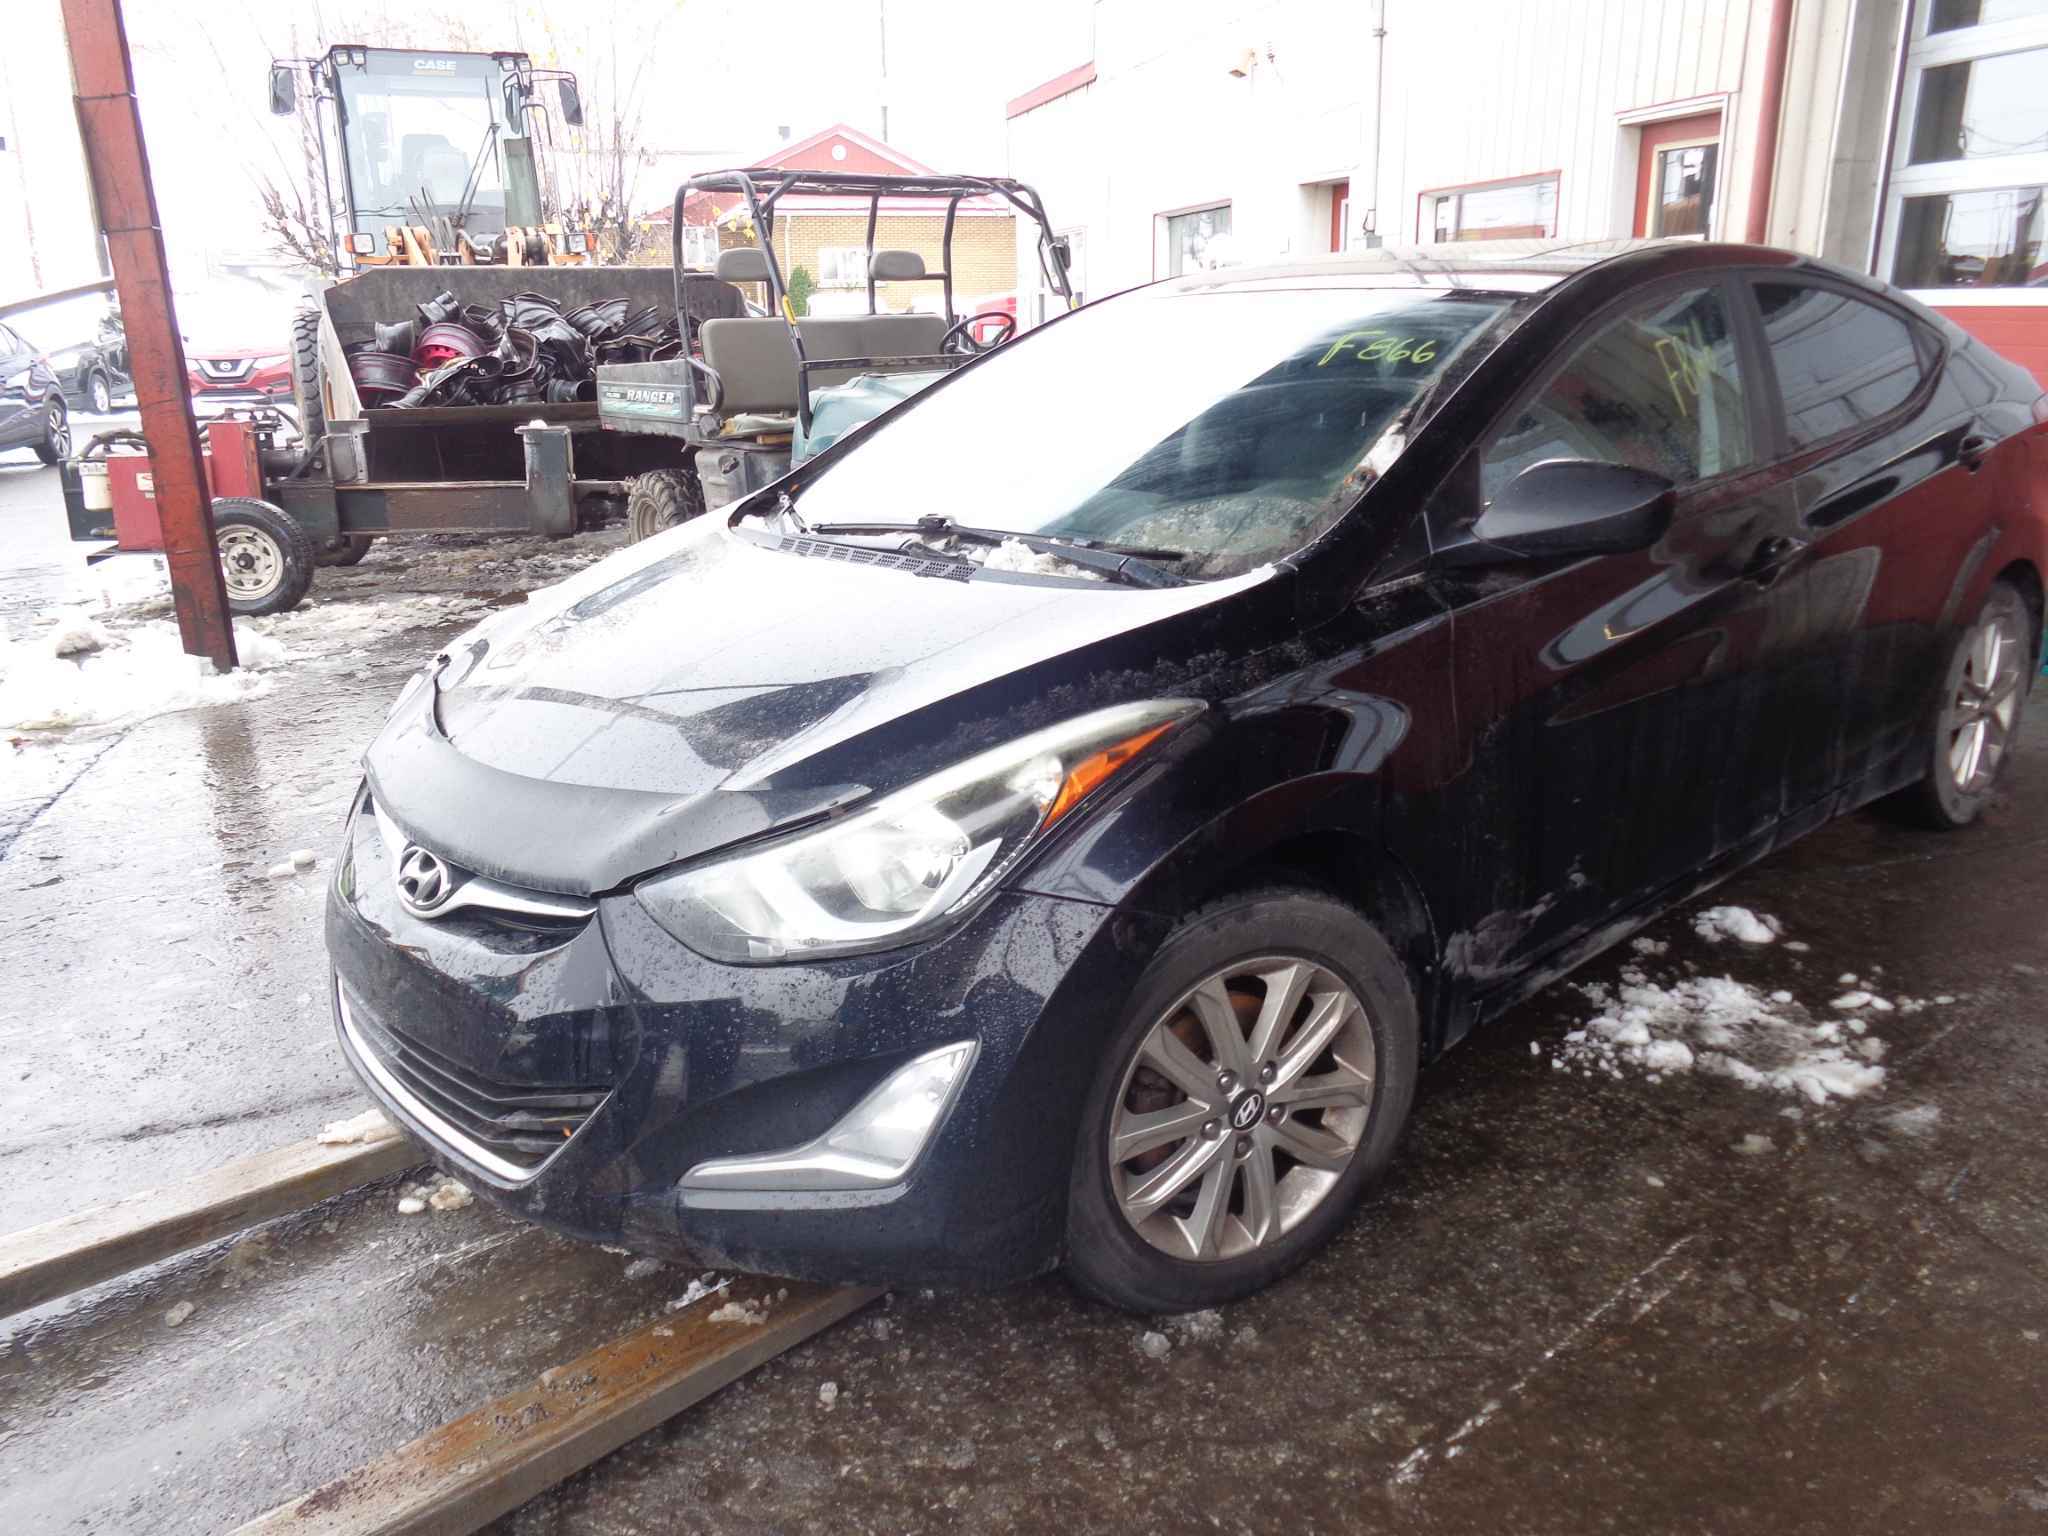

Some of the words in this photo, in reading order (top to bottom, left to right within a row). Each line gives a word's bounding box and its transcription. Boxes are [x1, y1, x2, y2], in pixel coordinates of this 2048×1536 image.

[414, 59, 457, 71] CASE
[1317, 330, 1436, 367] F866
[626, 389, 675, 404] RANGER
